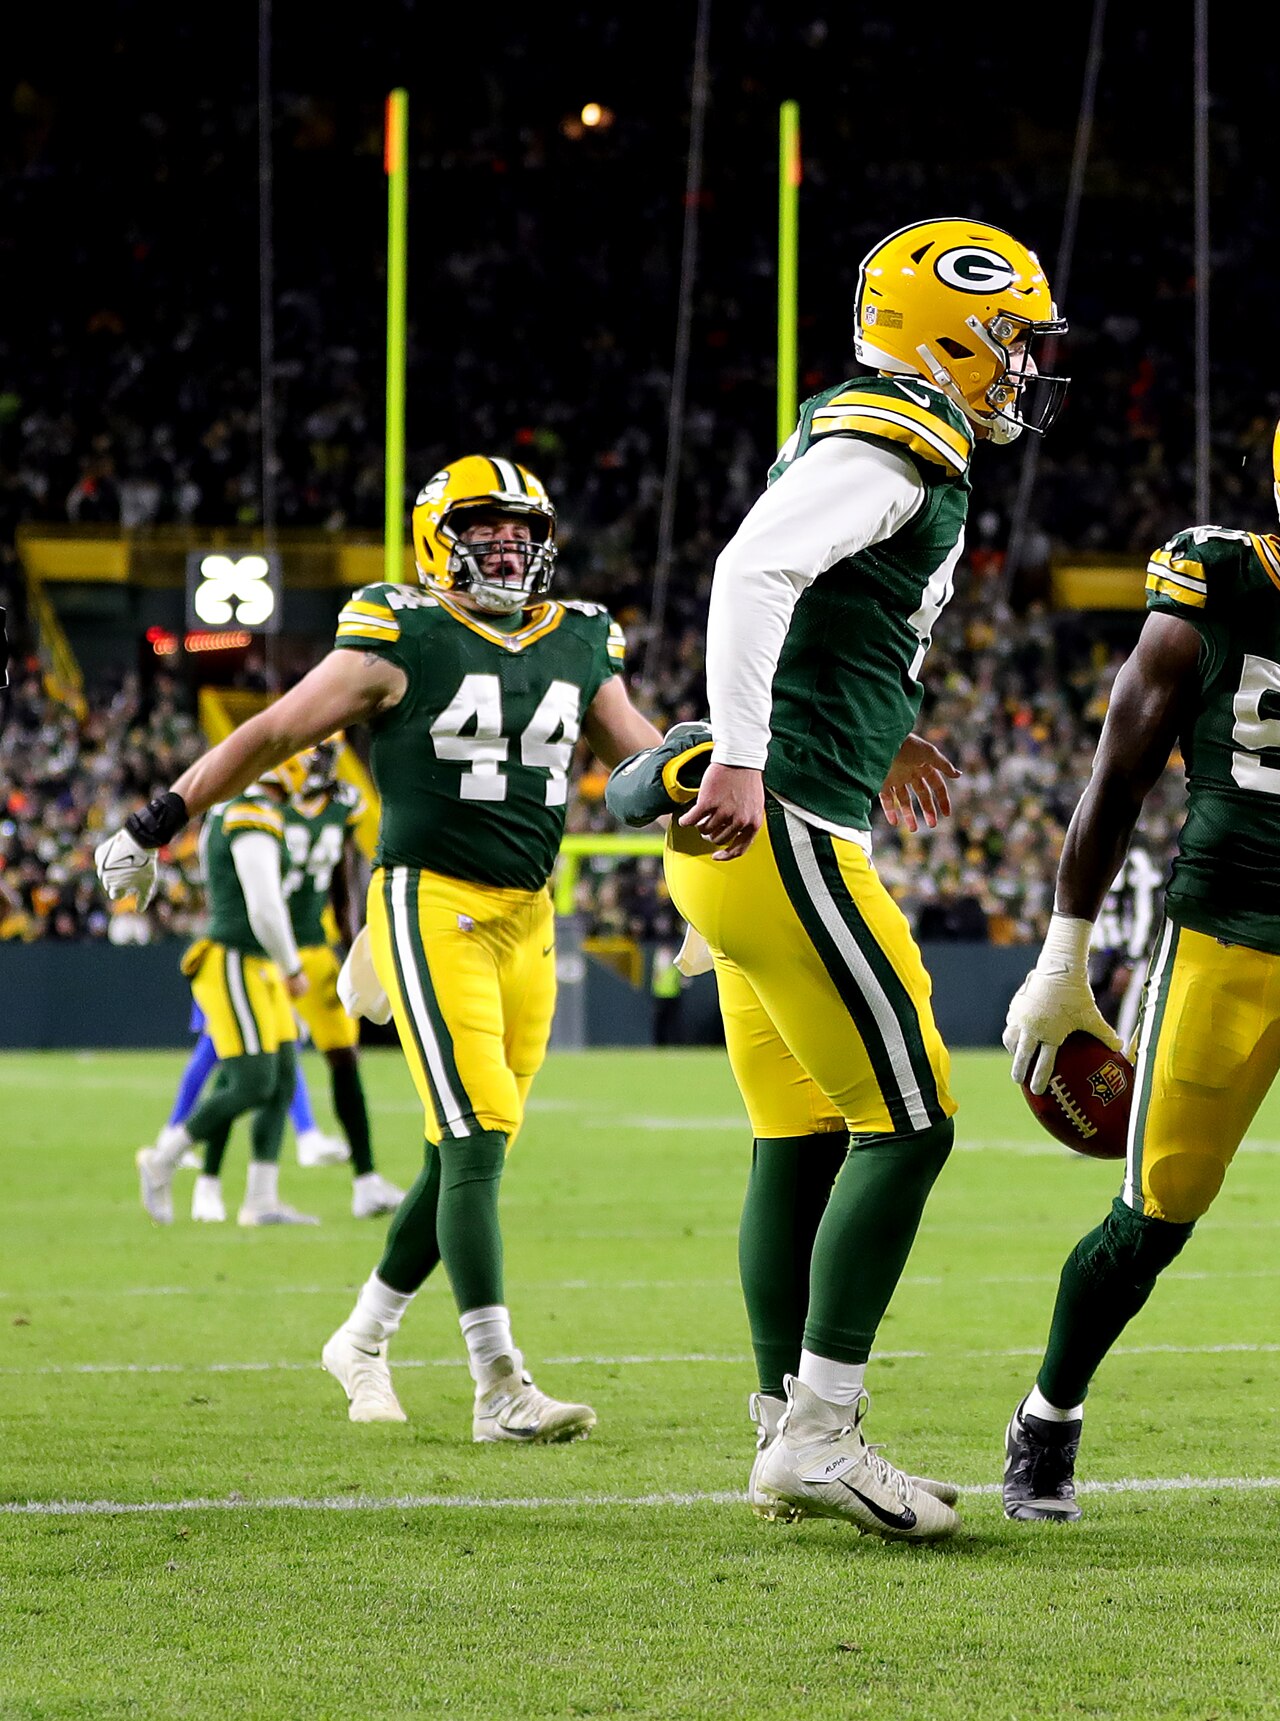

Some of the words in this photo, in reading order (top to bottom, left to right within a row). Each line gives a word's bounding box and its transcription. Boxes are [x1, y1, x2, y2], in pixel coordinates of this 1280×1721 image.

[936, 247, 1015, 294] G
[429, 673, 581, 807] 44
[1104, 1064, 1124, 1094] NFL
[824, 1456, 848, 1474] ALPHA
